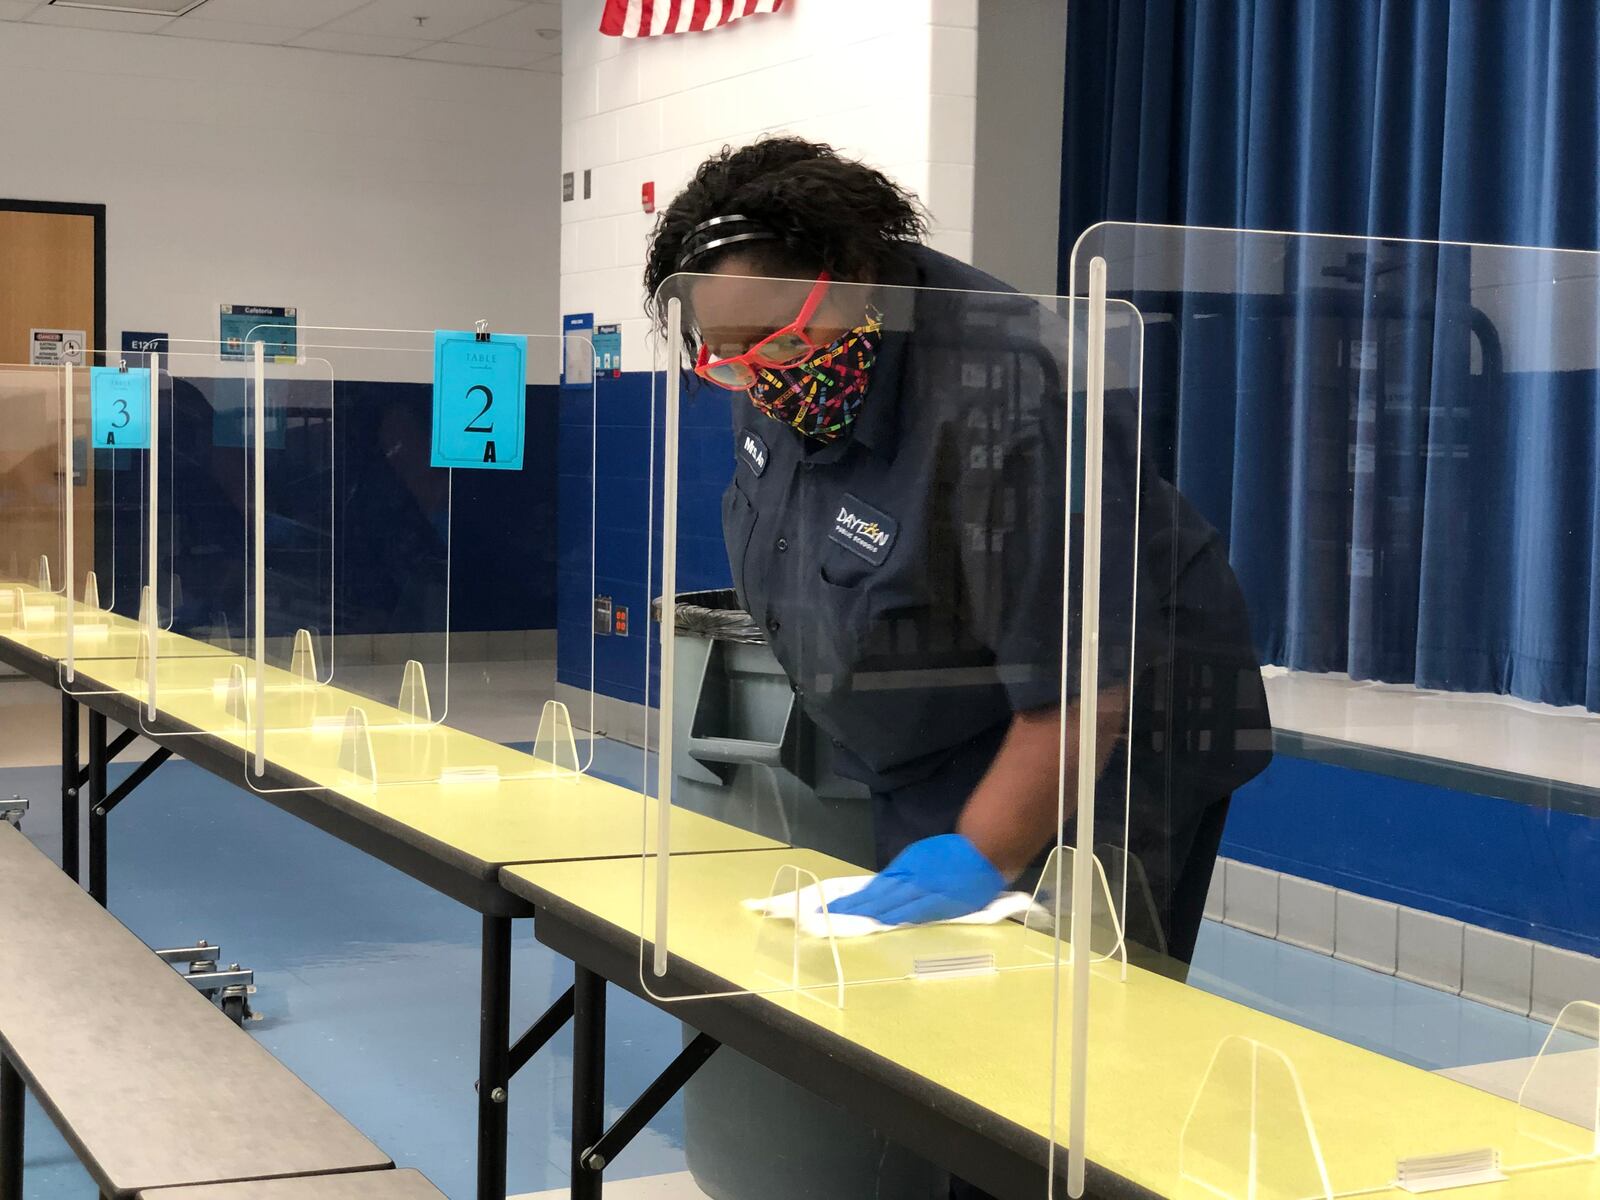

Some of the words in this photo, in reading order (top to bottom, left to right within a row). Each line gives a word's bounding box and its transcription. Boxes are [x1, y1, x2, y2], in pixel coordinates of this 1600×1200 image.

[131, 340, 159, 350] E1217
[466, 352, 497, 363] TABLE
[111, 399, 130, 429] 3
[464, 385, 494, 433] 2
[106, 431, 116, 445] A
[483, 441, 496, 463] A
[836, 507, 890, 546] DAYTON
